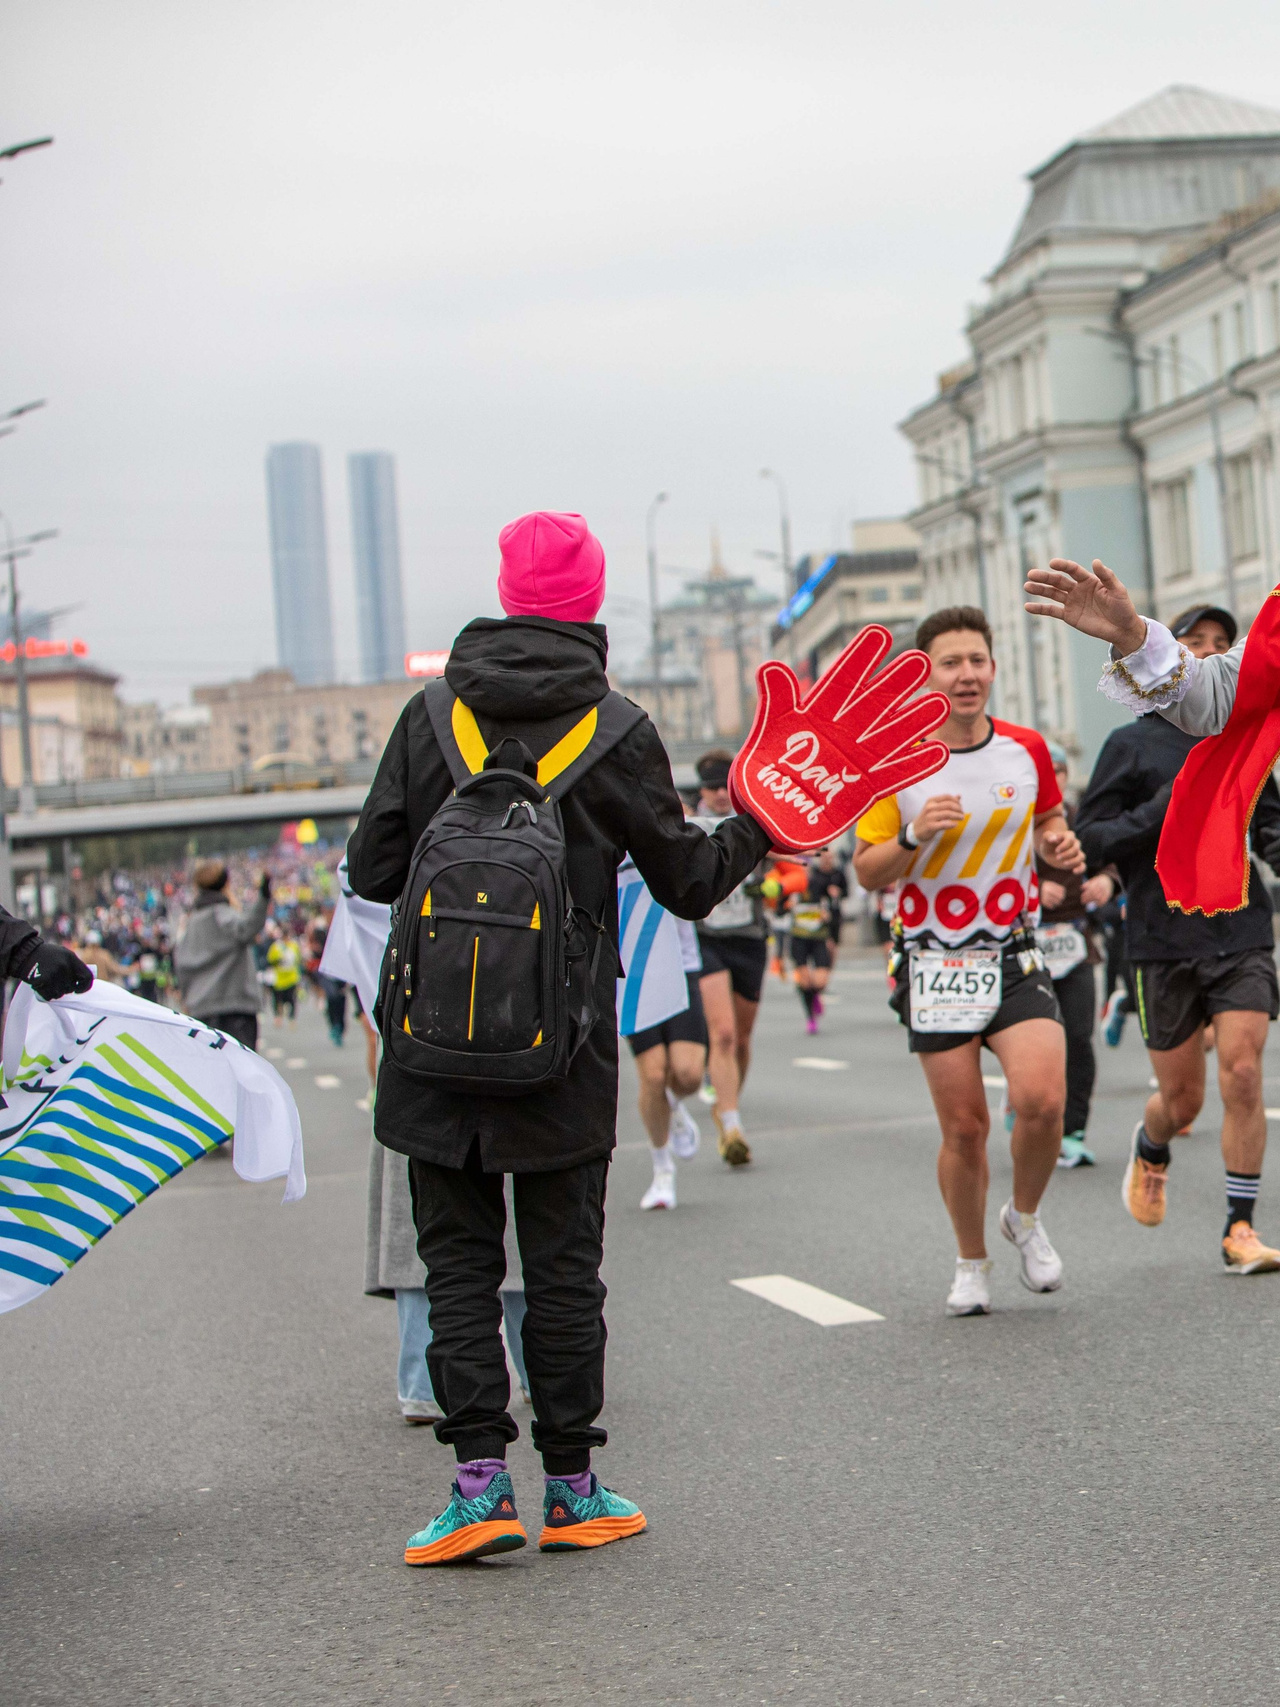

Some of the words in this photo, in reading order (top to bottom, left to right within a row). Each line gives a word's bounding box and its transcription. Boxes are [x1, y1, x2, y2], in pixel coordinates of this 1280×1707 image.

[777, 731, 862, 805] Дай
[756, 763, 826, 826] пять
[914, 970, 997, 996] 14459
[917, 1008, 928, 1024] C
